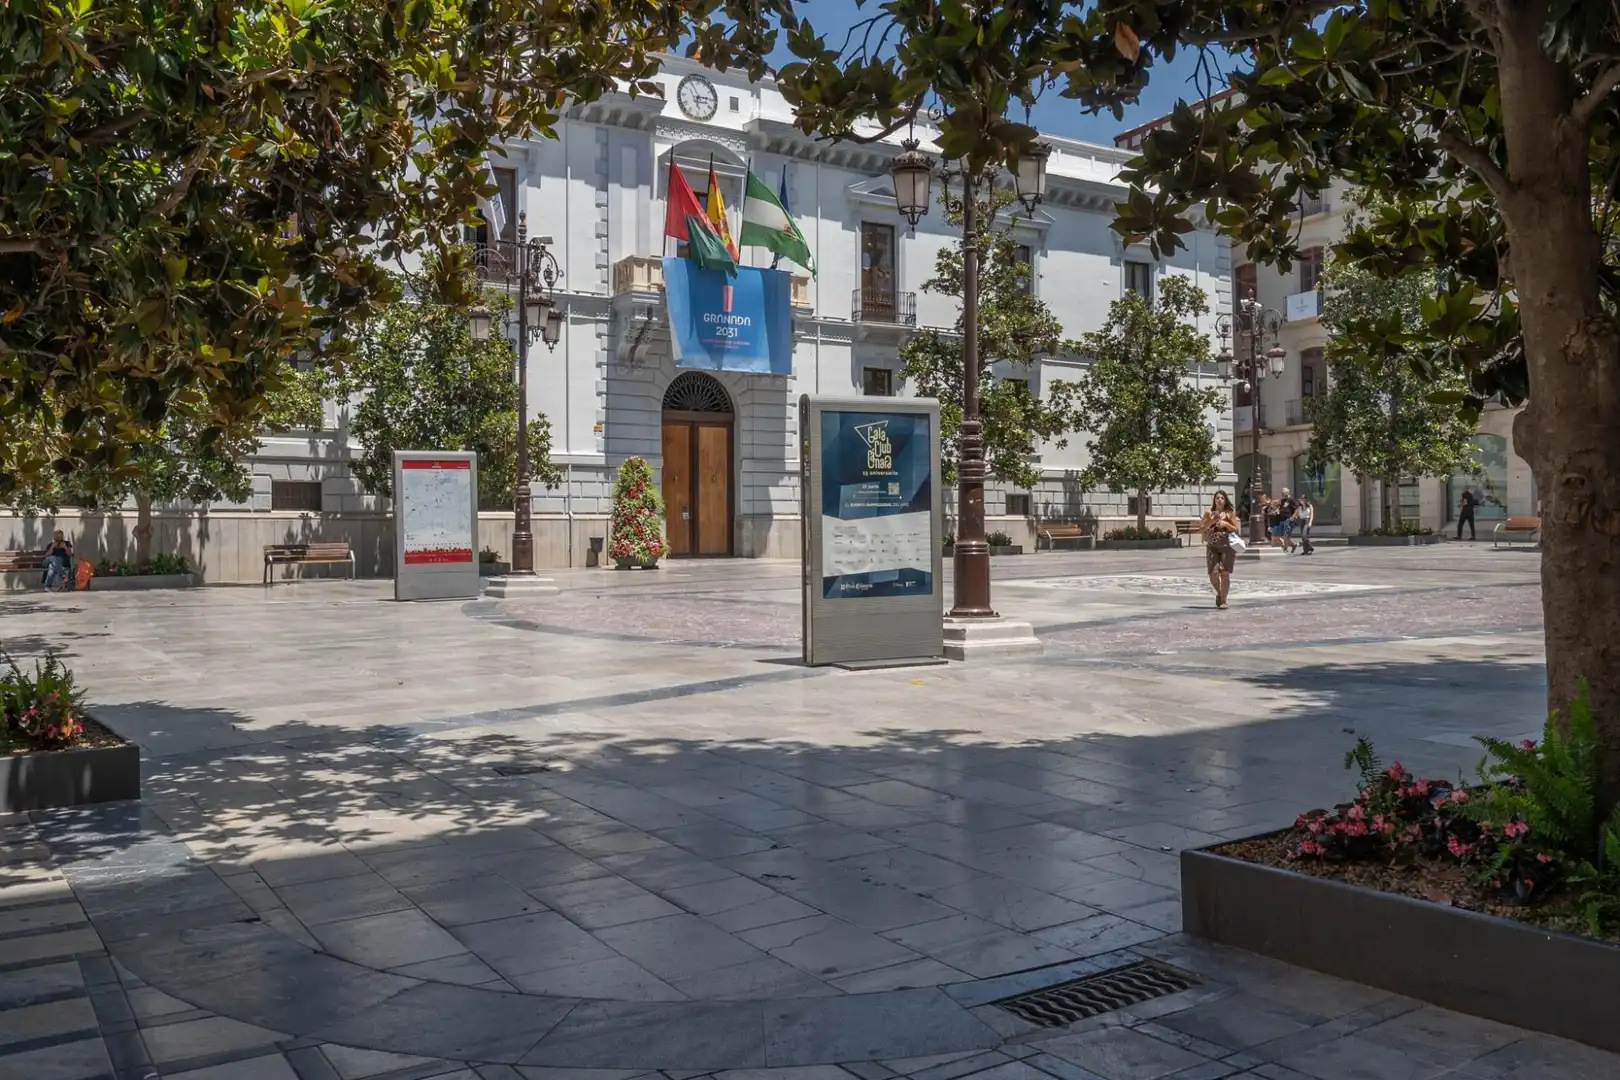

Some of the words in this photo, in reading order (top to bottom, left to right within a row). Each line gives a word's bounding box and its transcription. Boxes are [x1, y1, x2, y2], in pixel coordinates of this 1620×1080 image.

[703, 313, 751, 326] GRANADA
[715, 326, 738, 338] 2031
[867, 426, 886, 443] Gala
[874, 437, 892, 457] Club
